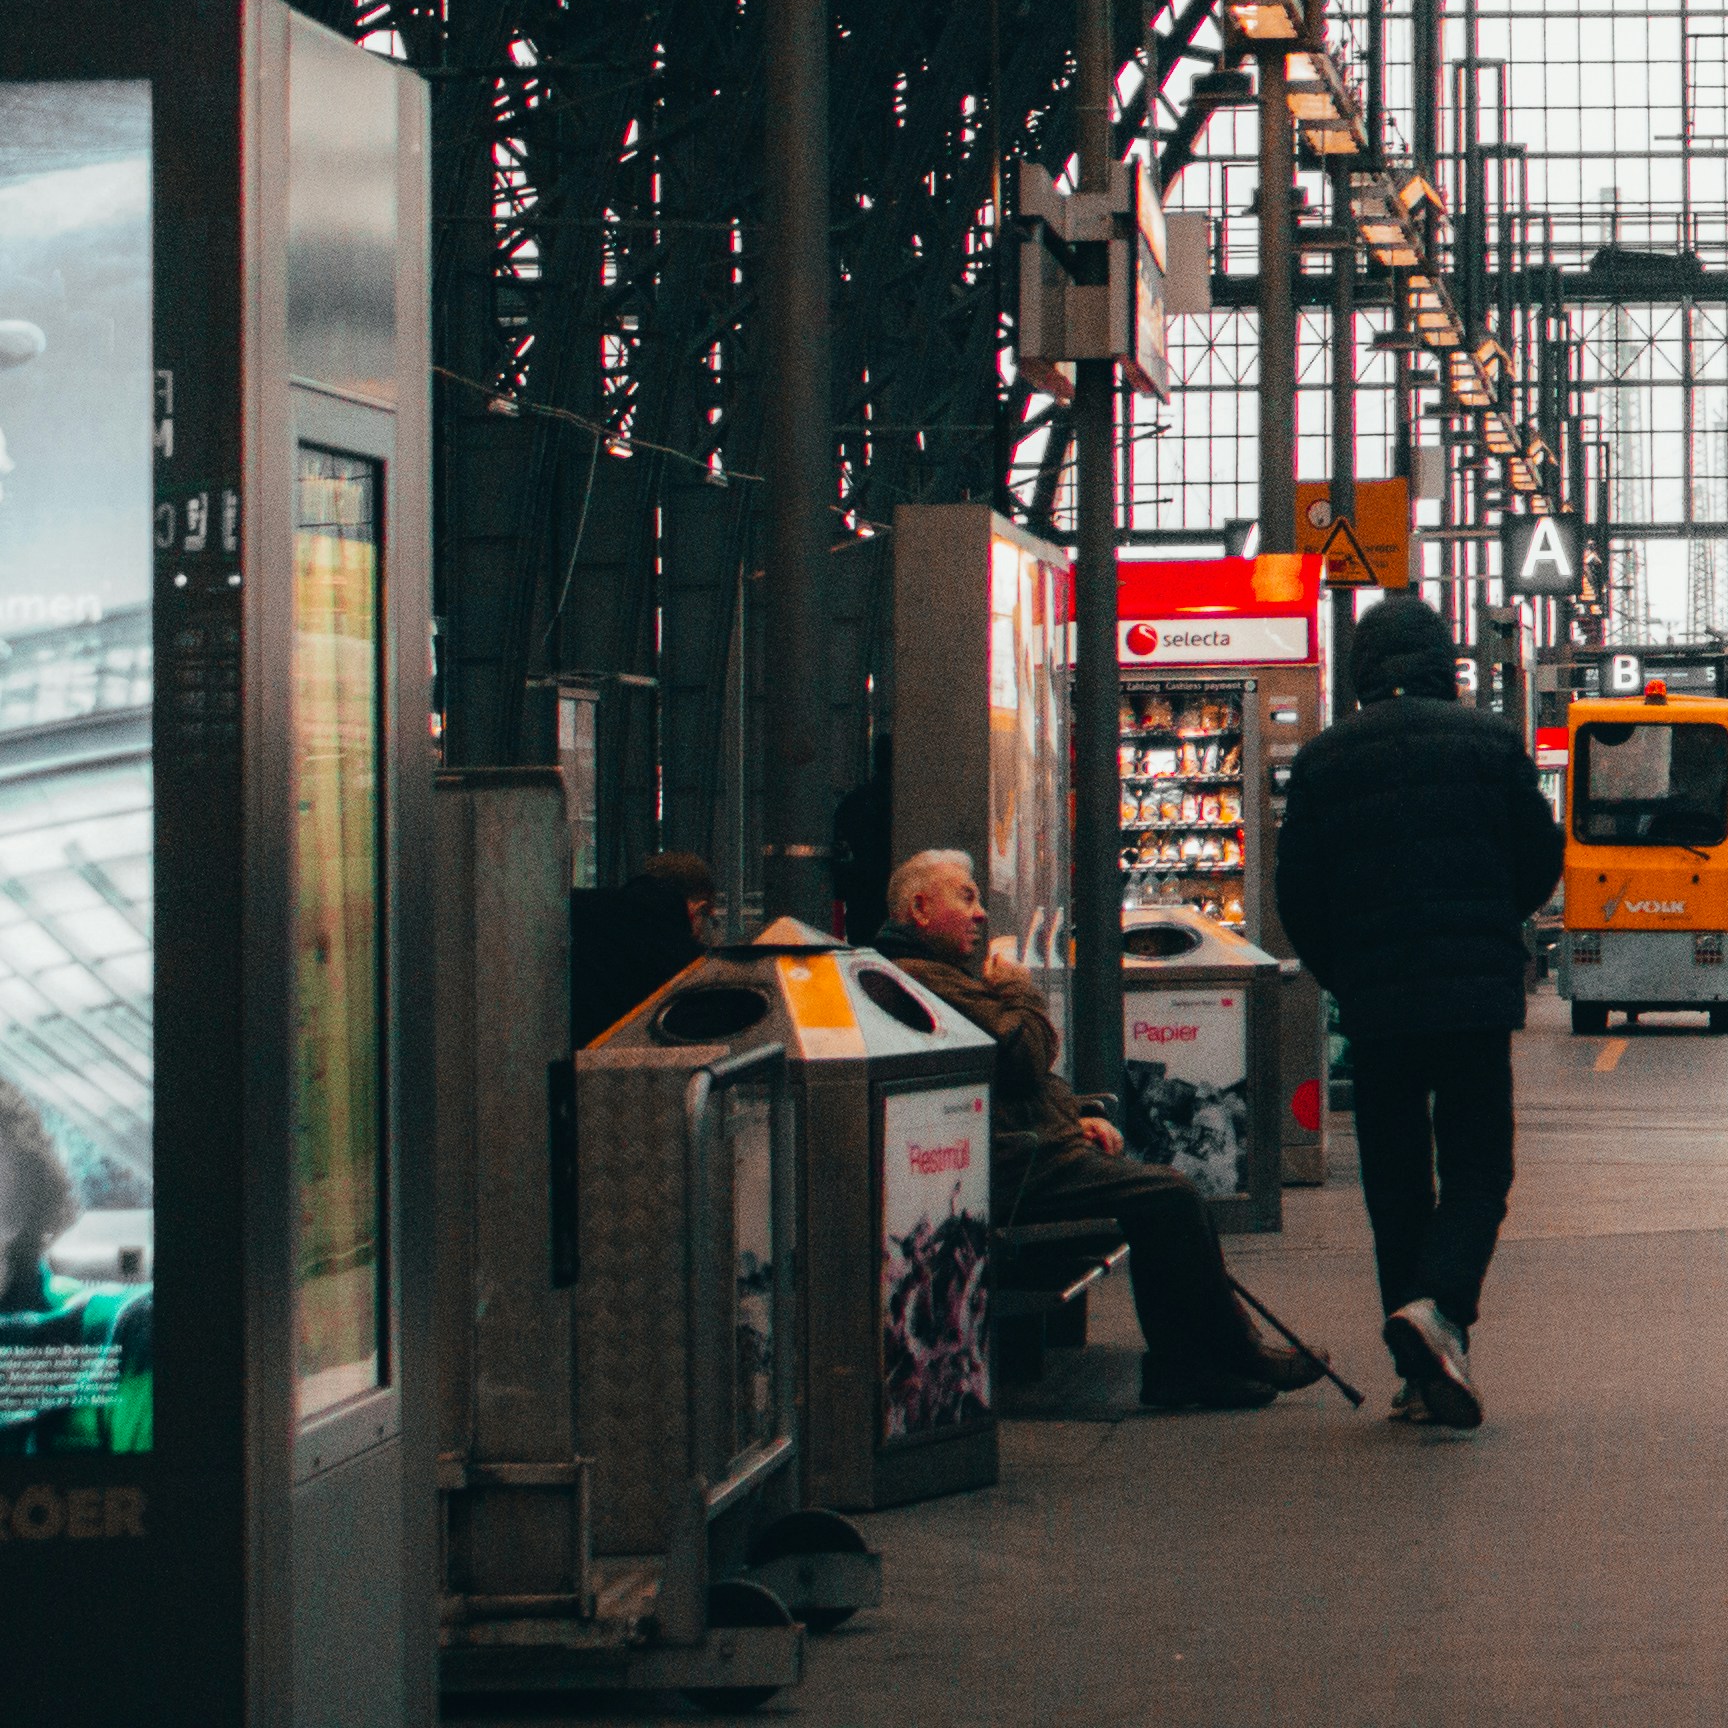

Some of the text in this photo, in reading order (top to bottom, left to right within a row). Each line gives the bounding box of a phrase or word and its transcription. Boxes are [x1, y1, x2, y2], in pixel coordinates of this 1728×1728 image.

[1521, 517, 1572, 577] A
[1162, 630, 1231, 648] selecta
[1613, 655, 1640, 690] B
[1133, 1021, 1200, 1046] Papier
